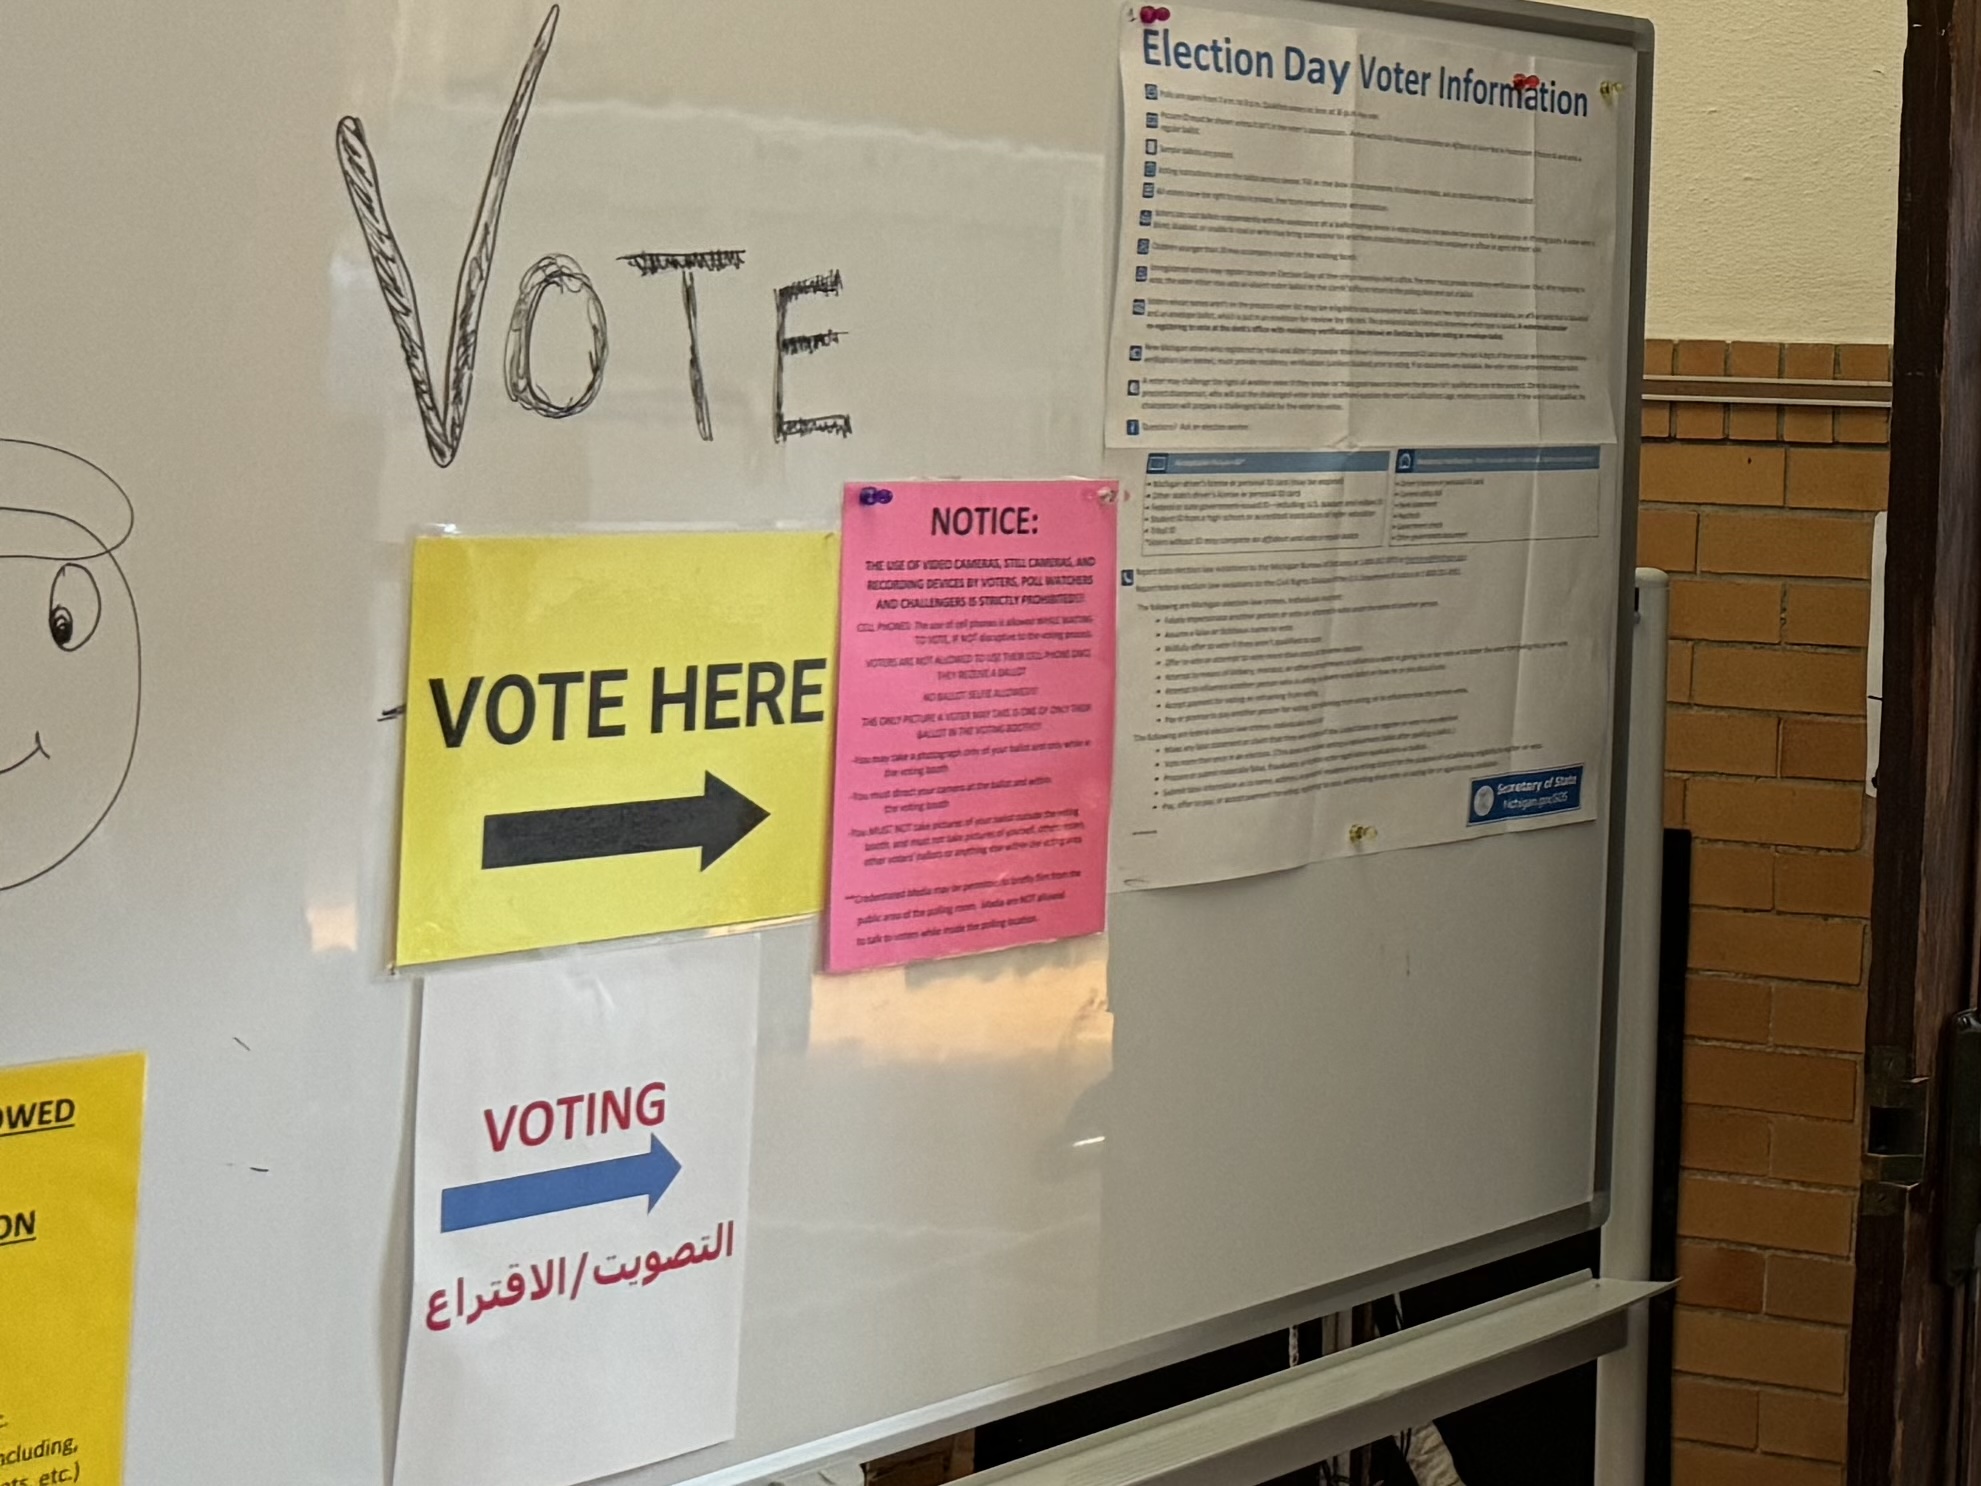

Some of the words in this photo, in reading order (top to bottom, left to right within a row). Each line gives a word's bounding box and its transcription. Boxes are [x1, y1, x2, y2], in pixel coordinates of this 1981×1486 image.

[1143, 28, 1273, 78] Election
[1285, 46, 1351, 95] Day
[1360, 54, 1431, 97] Voter
[1440, 66, 1588, 117] Information
[336, 4, 852, 468] VOTE
[931, 506, 1039, 536] NOTICE:
[429, 669, 628, 749] VOTE
[651, 658, 827, 734] HERE
[484, 1082, 666, 1153] VOTING
